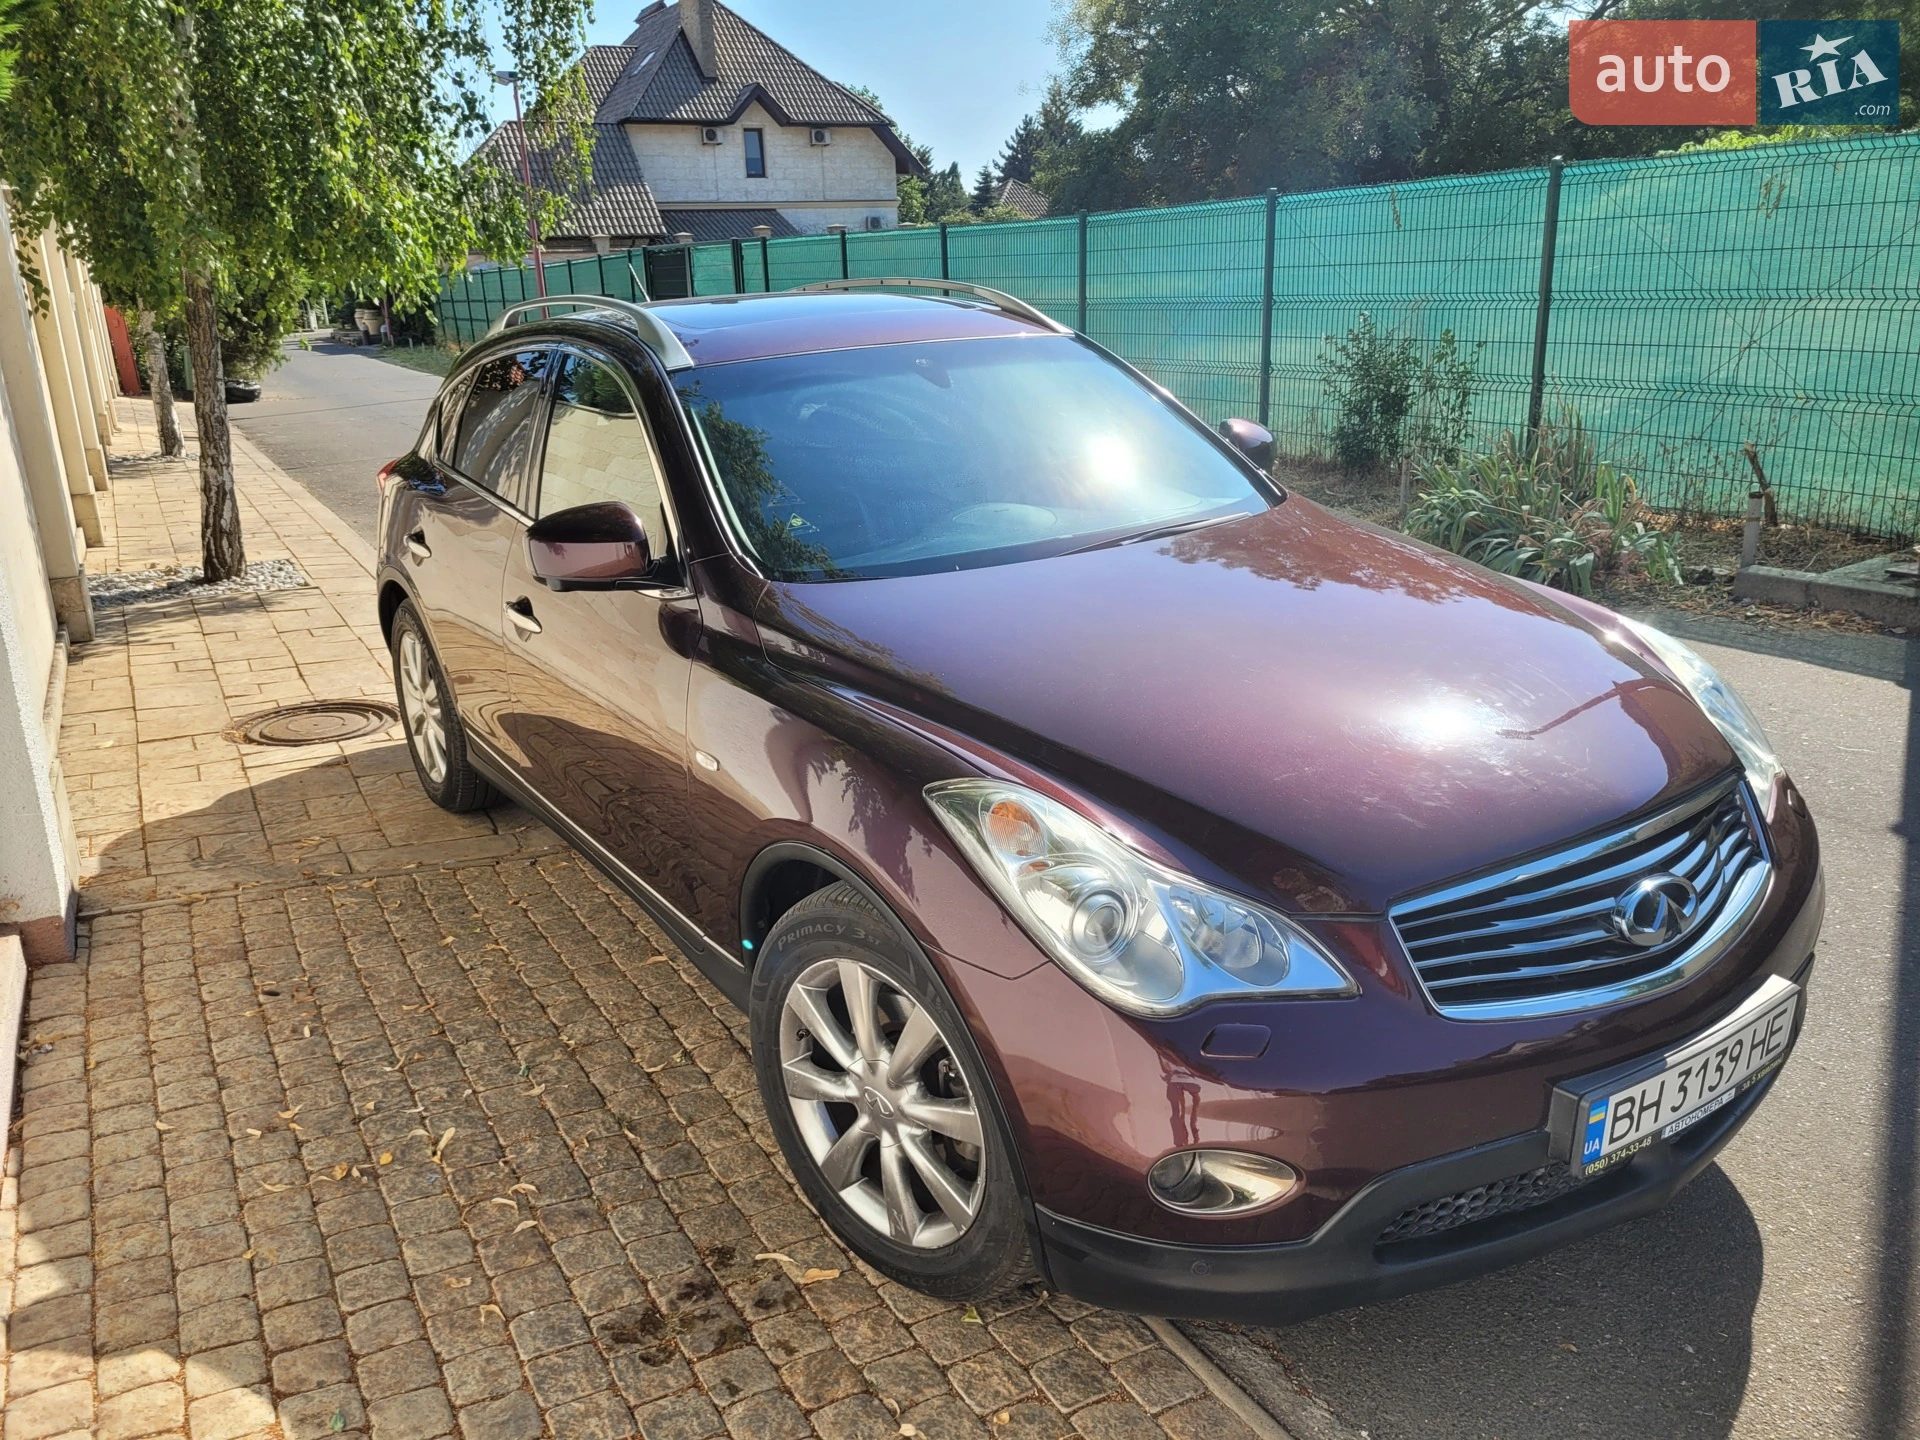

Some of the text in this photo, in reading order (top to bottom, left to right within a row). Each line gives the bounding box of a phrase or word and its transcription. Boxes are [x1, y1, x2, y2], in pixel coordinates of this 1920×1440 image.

[777, 923, 846, 952] PRIMACY
[851, 927, 867, 939] 3
[1608, 1080, 1665, 1146] BH
[1670, 1038, 1744, 1113] 3139
[1746, 1007, 1788, 1070] HE
[1668, 1097, 1724, 1135] АВТОНОМЕРА
[1584, 1137, 1600, 1155] UA
[1585, 1136, 1652, 1176] (050) 374-33-48
